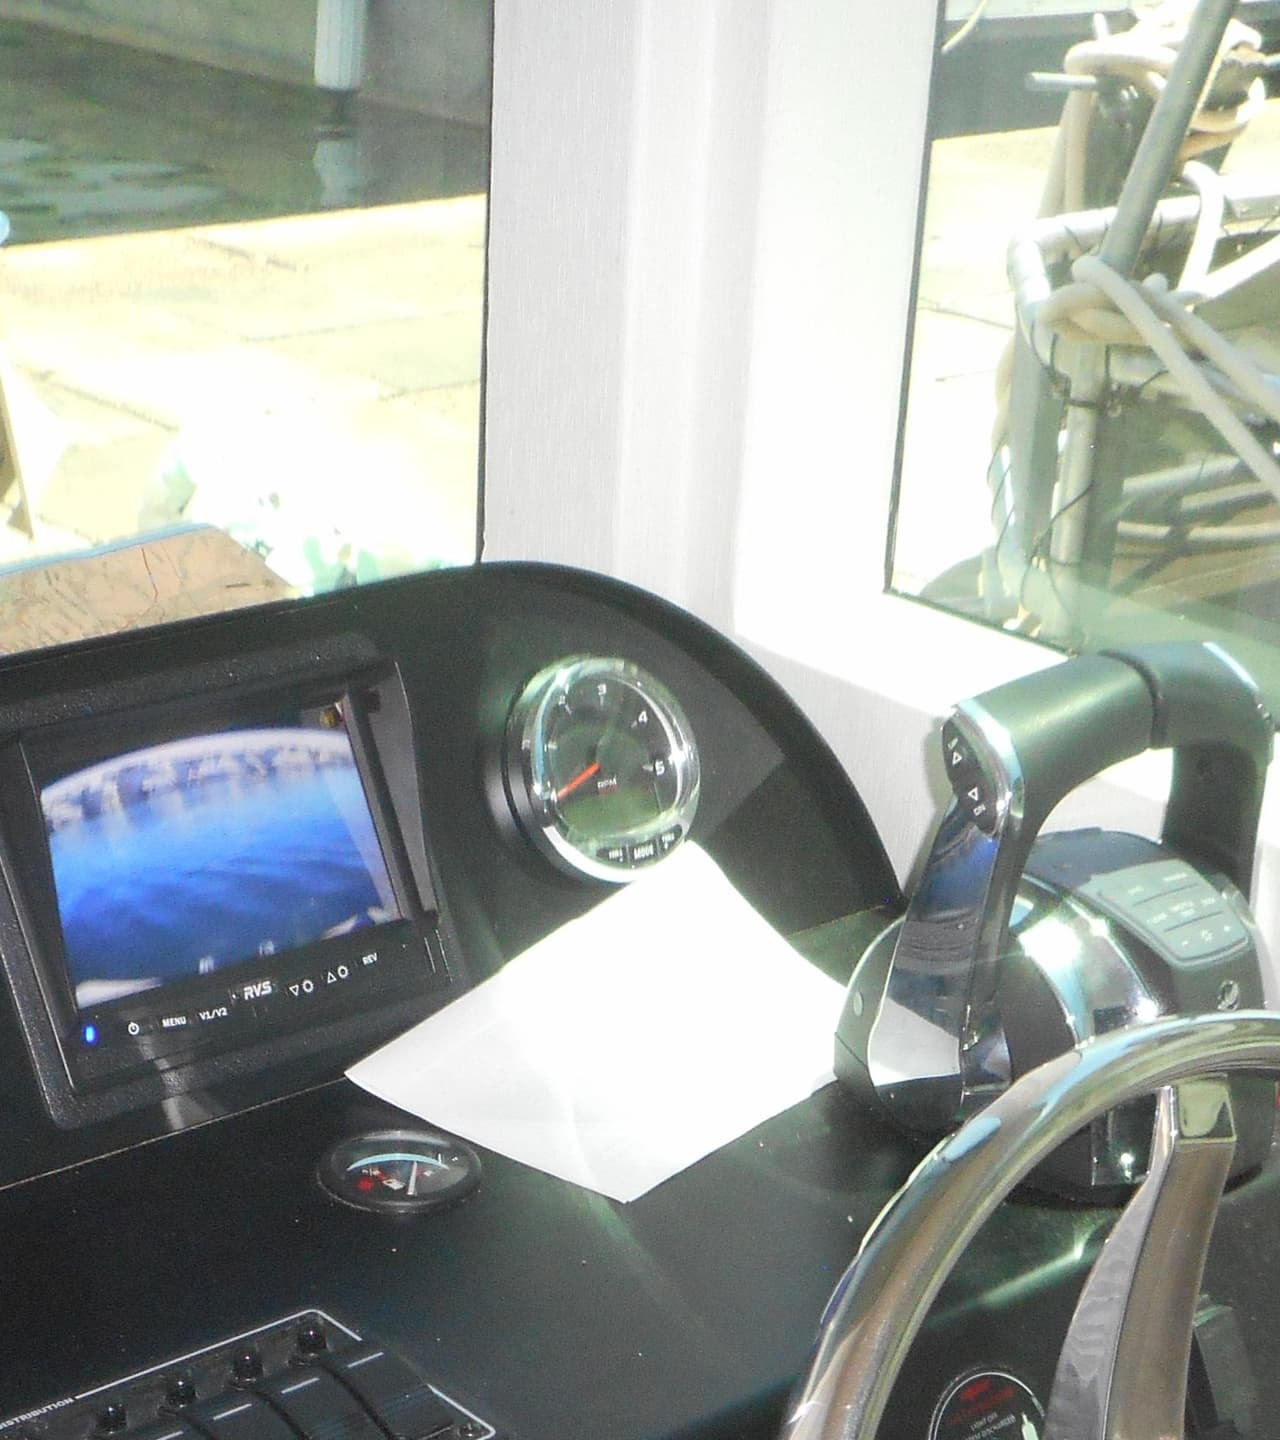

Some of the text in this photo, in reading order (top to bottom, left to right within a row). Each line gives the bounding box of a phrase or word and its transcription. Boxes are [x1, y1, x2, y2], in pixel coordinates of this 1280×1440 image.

[638, 710, 648, 723] 4
[655, 760, 665, 776] 5
[362, 952, 378, 965] REV
[243, 981, 273, 1000] RVS
[162, 1006, 228, 1028] MENU V1/V2
